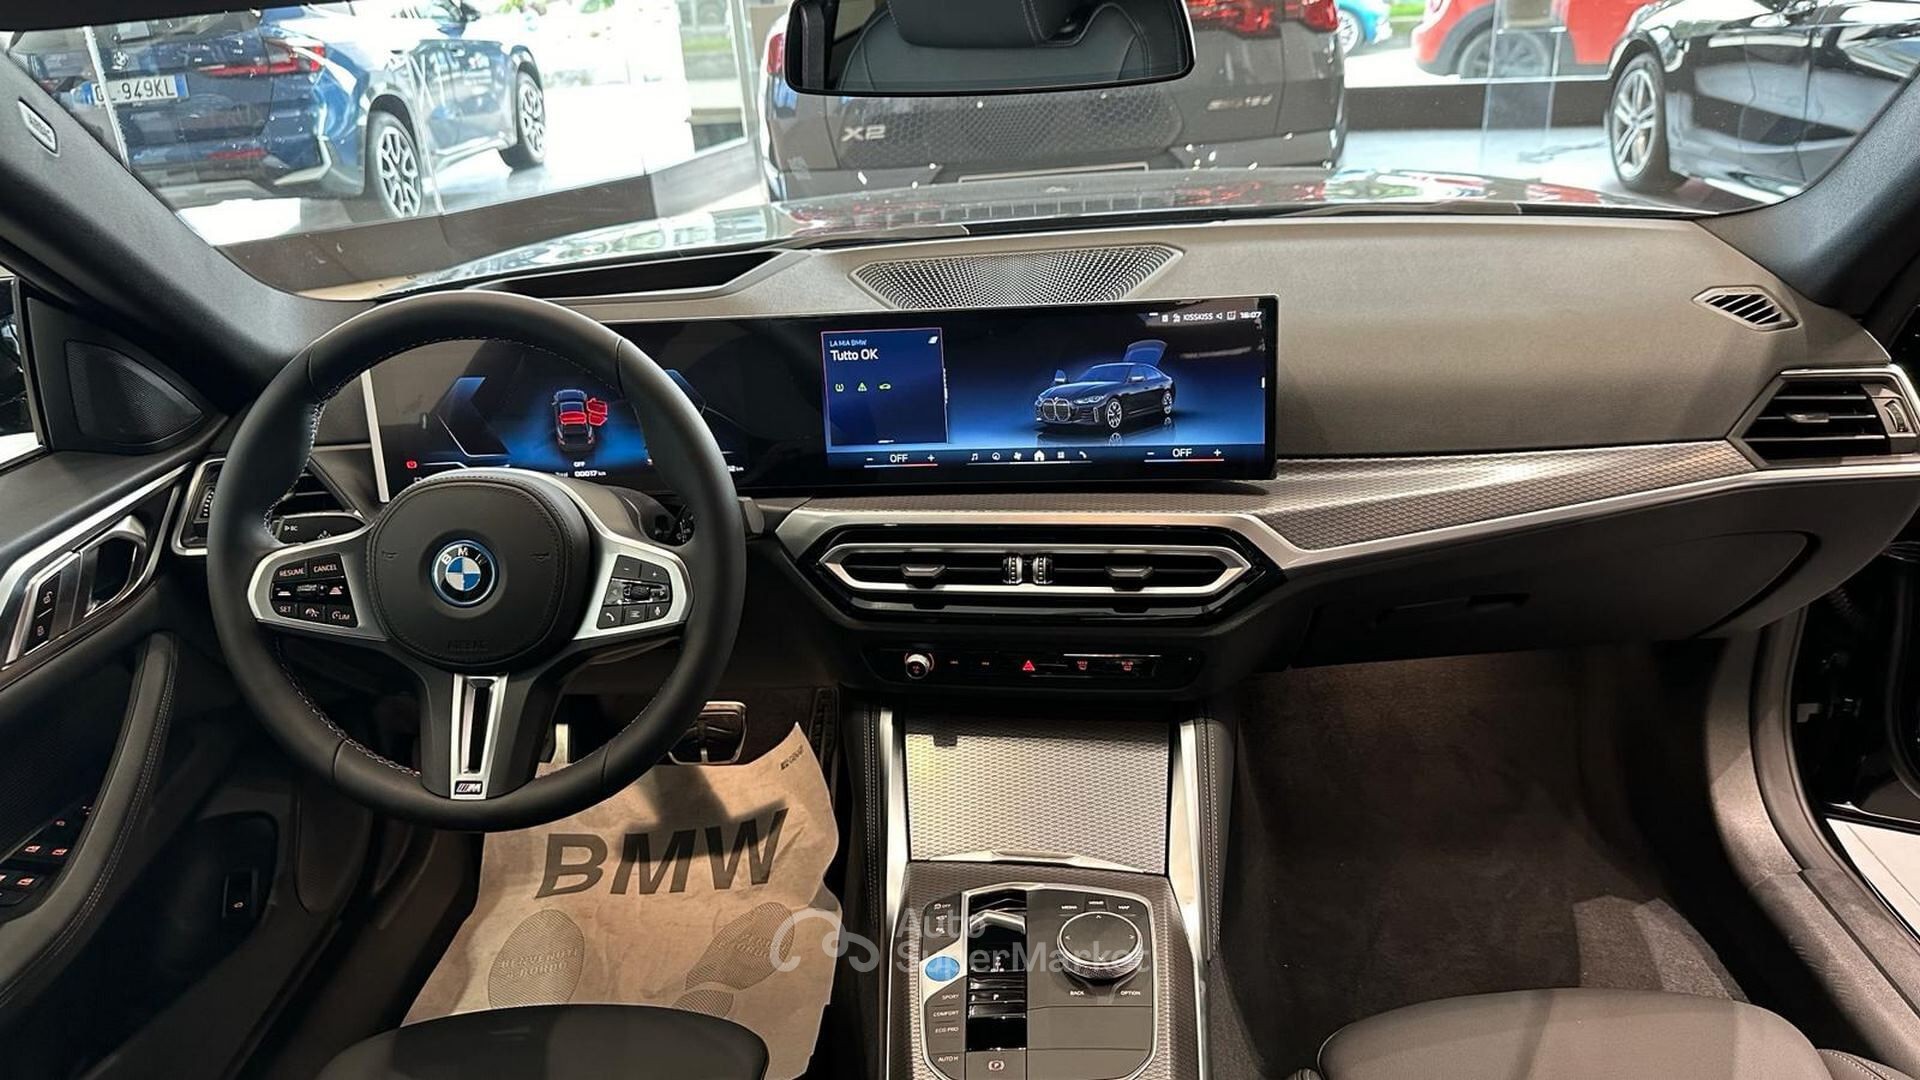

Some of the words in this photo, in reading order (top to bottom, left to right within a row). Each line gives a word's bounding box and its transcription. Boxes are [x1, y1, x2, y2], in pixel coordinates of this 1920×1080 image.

[121, 79, 175, 100] 949KL
[841, 125, 886, 141] X2
[830, 350, 859, 361] Tutto
[860, 348, 879, 360] OK
[1172, 448, 1192, 457] OFF
[889, 454, 908, 463] OFF
[441, 546, 487, 566] BMW
[279, 567, 305, 577] RESUME
[313, 564, 337, 573] CANCEL
[280, 605, 291, 613] SET
[535, 808, 789, 900] BMW
